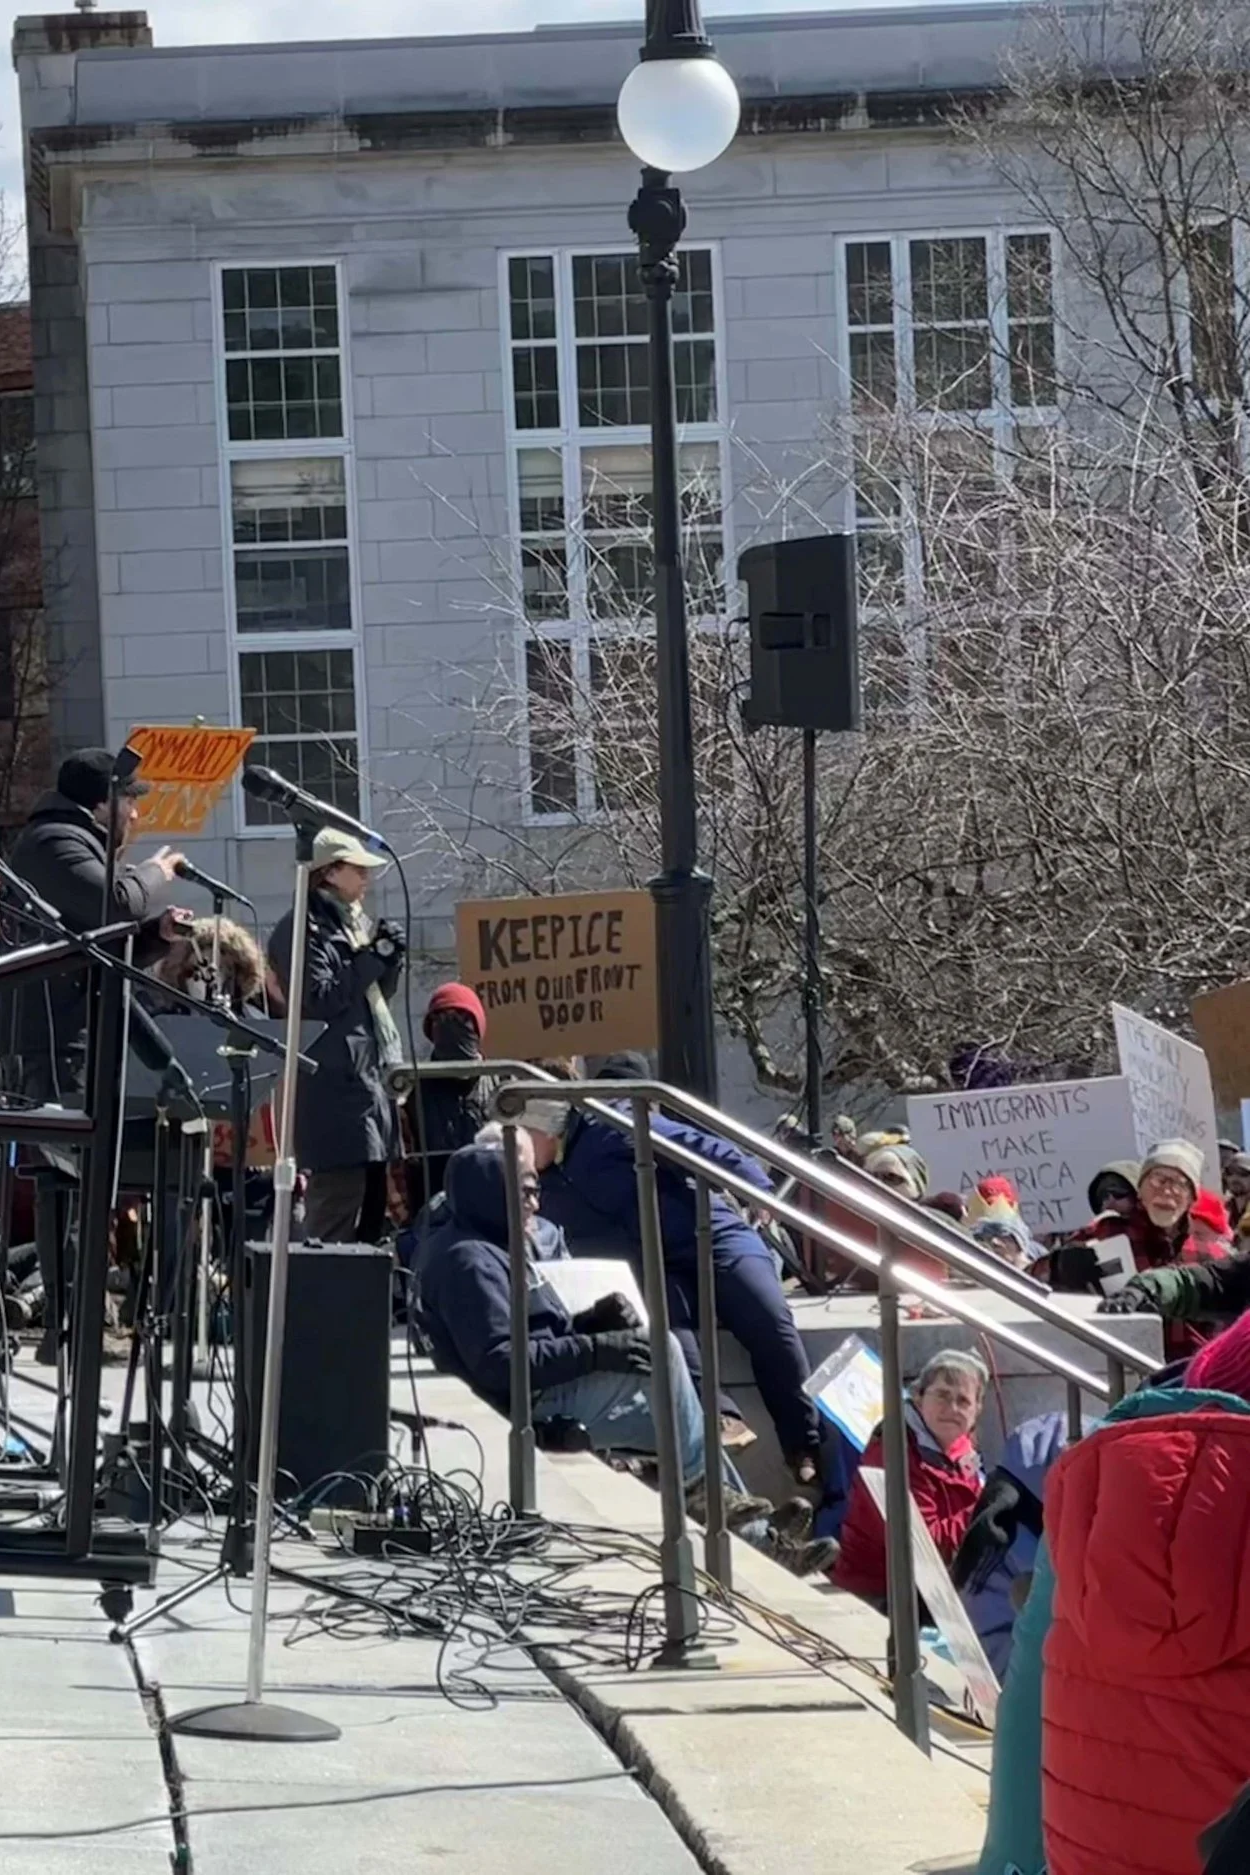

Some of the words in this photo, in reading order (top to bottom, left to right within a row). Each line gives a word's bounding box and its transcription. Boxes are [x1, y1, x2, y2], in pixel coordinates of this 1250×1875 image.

[478, 917, 565, 971] KEEP
[567, 910, 624, 958] ICE
[475, 975, 527, 1009] FROM
[535, 974, 575, 1001] OUR
[575, 964, 642, 995] FRONT
[538, 1000, 603, 1031] DOOR
[933, 1086, 1091, 1131] IMMIGRANTS
[981, 1130, 1056, 1160] MAKE
